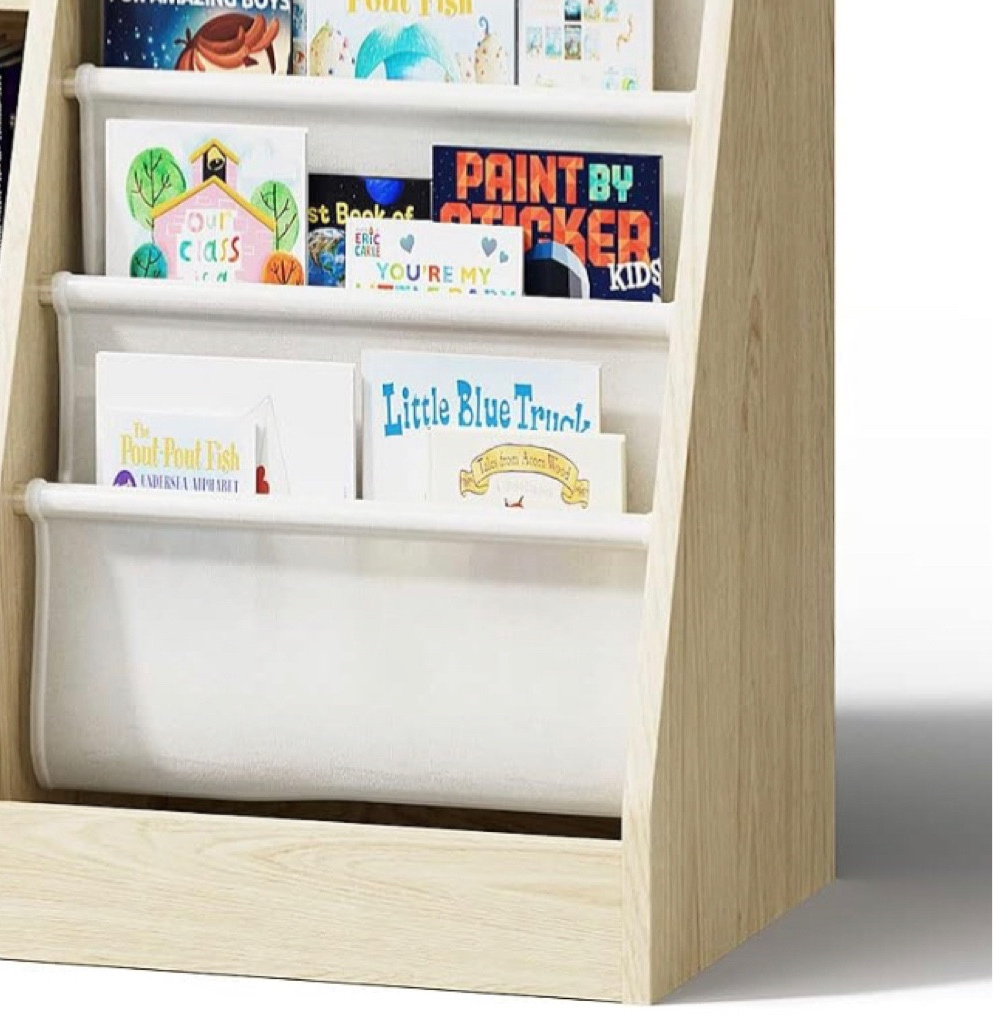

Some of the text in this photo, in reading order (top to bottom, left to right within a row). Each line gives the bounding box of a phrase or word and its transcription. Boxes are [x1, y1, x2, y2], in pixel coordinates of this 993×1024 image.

[455, 150, 634, 205] PAINT BY
[178, 234, 241, 264] class
[354, 232, 381, 245] ERIC
[354, 245, 381, 258] CARLE
[376, 261, 492, 286] YOU'RE MY
[607, 256, 662, 292] KIDS
[382, 382, 451, 437] Little
[456, 379, 512, 430] Blue
[133, 420, 150, 438] The
[119, 433, 241, 473] Pout-Pout Fish
